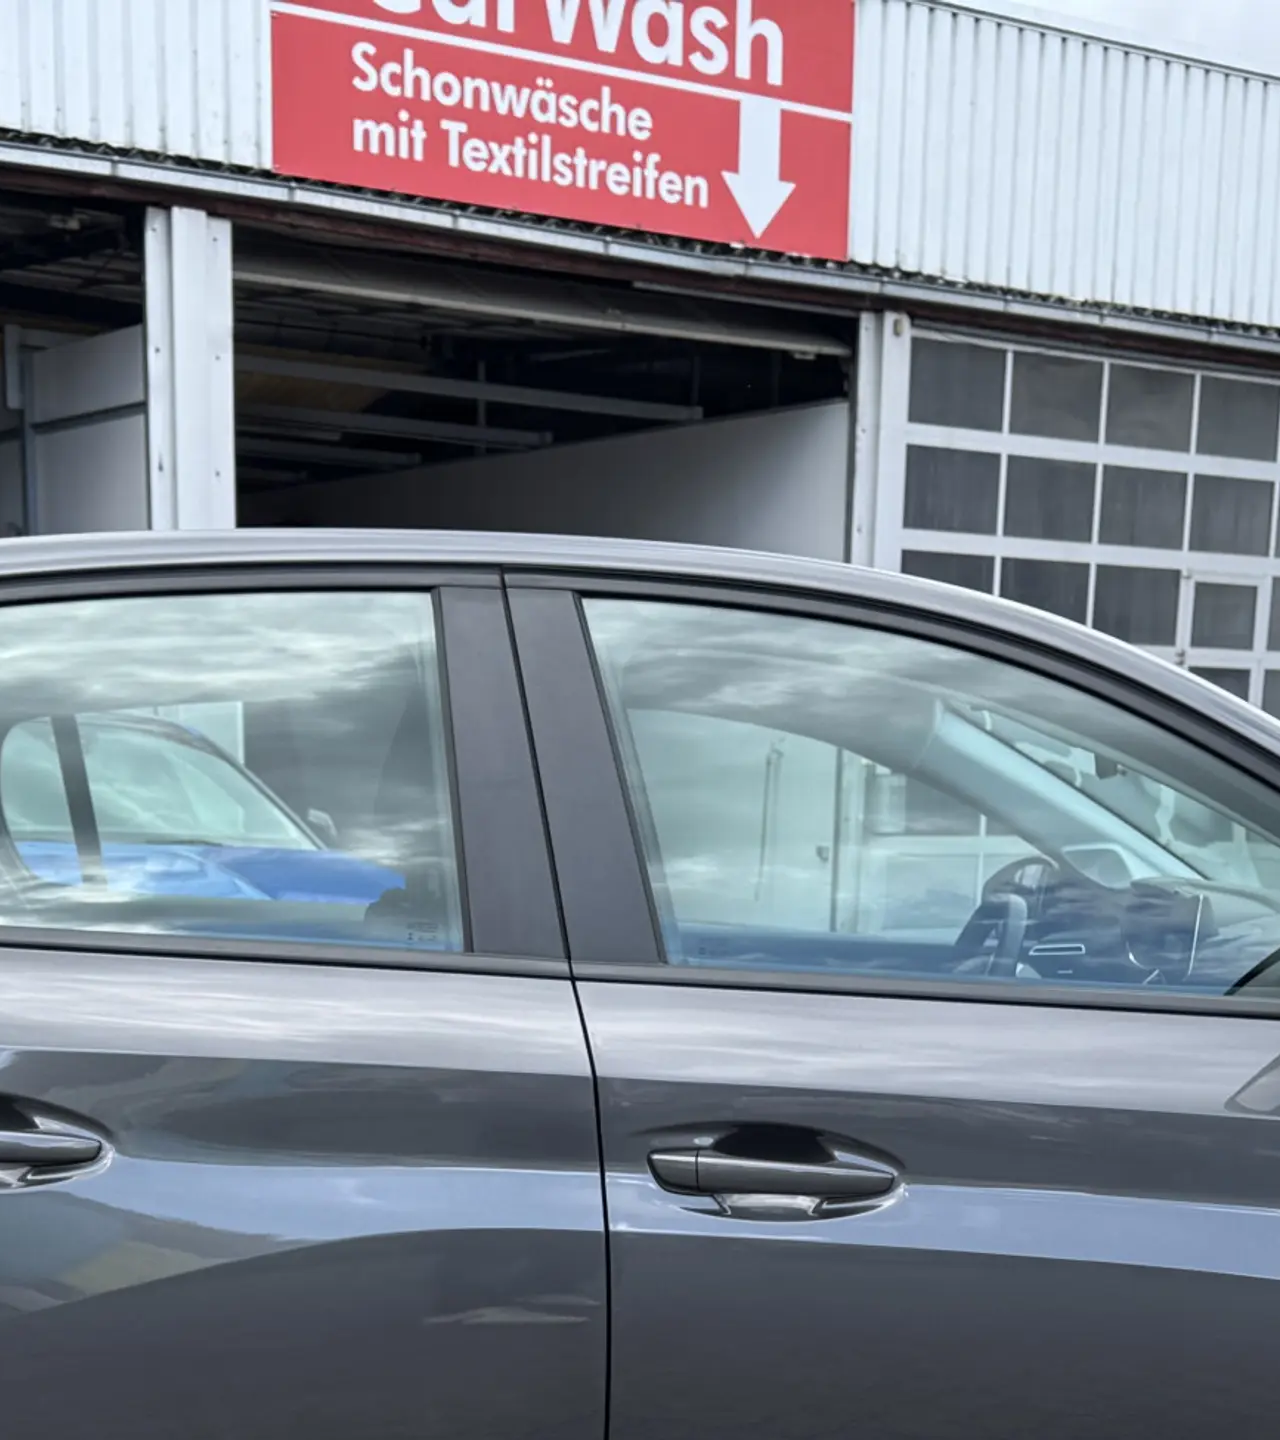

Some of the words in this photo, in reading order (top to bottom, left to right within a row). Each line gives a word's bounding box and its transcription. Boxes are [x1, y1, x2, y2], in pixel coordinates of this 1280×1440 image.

[351, 41, 653, 141] Schonwäsche
[352, 109, 427, 162] mit
[440, 118, 709, 208] Textilstreifen
